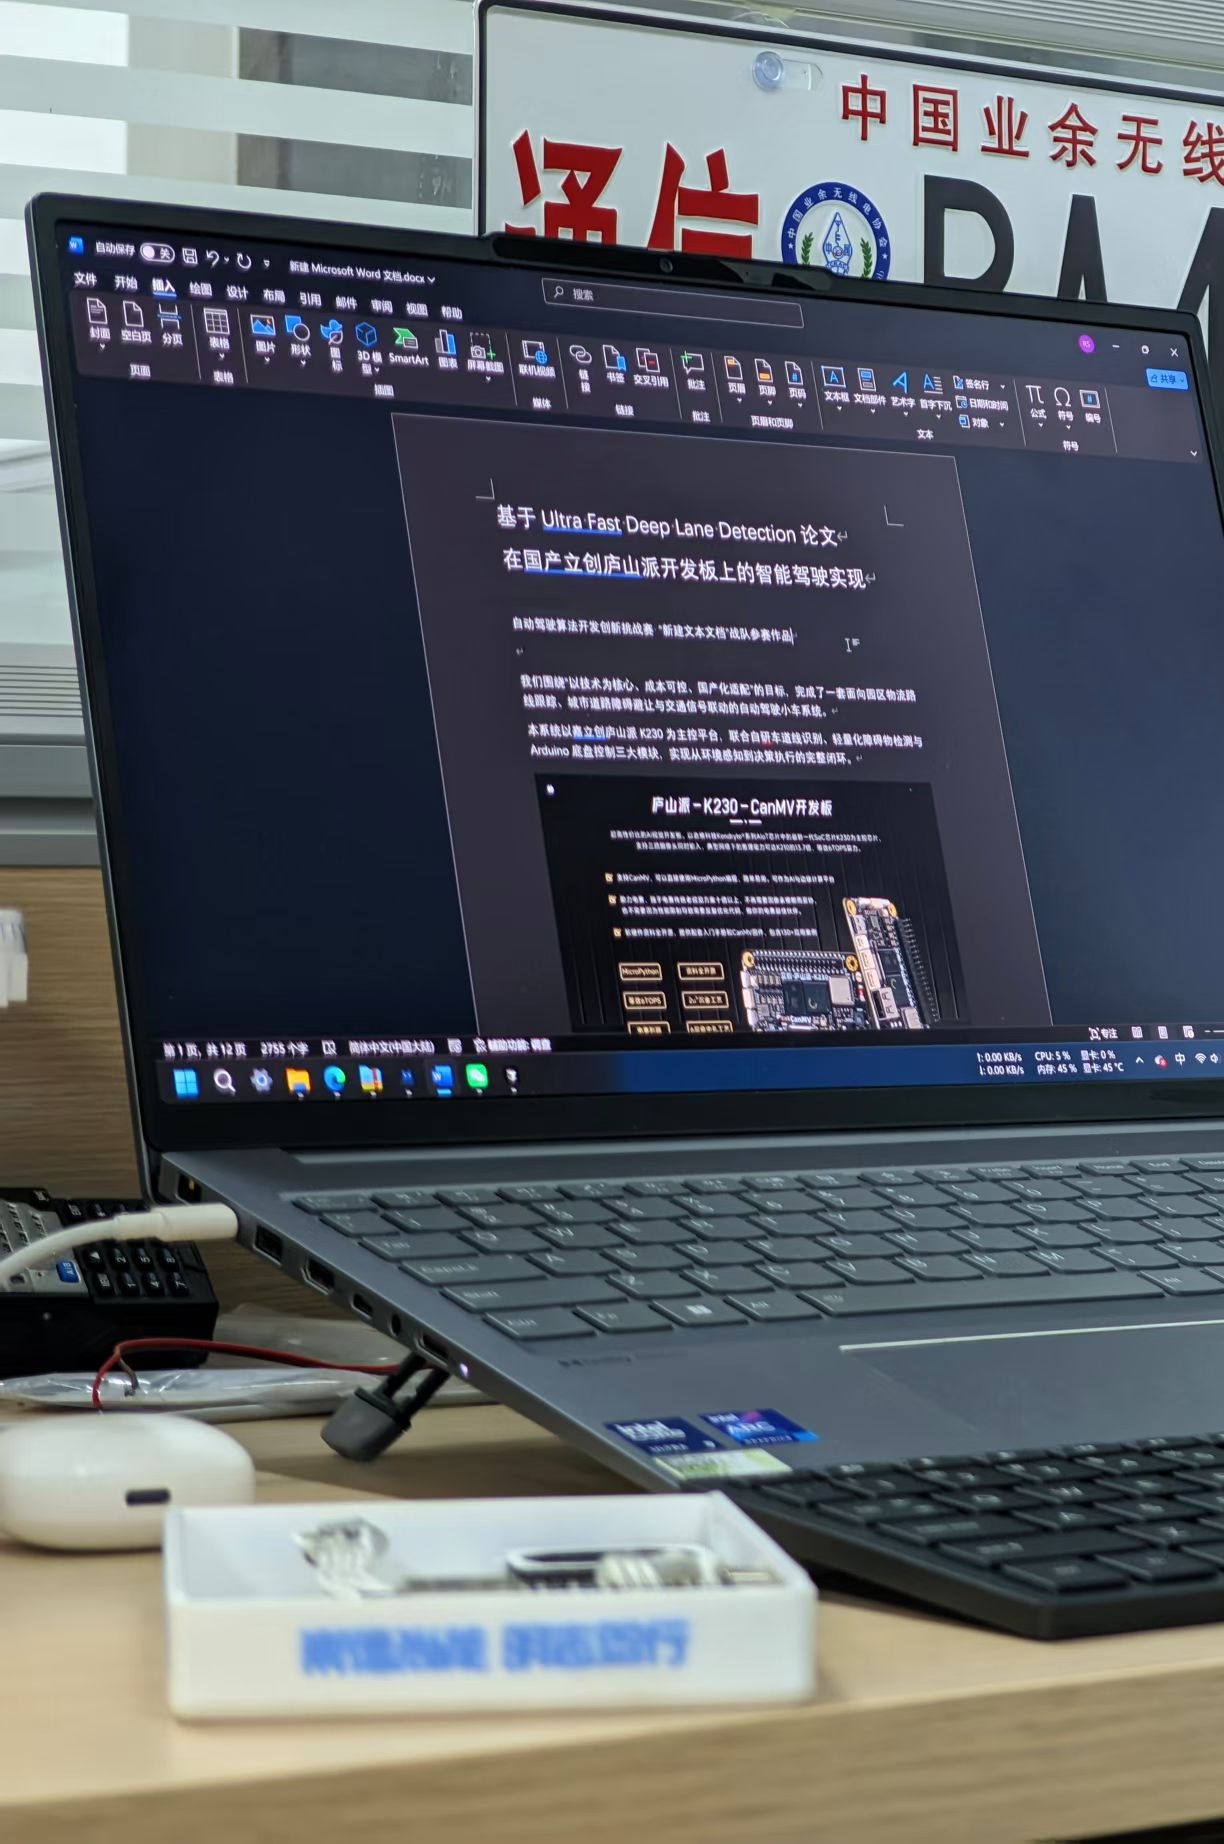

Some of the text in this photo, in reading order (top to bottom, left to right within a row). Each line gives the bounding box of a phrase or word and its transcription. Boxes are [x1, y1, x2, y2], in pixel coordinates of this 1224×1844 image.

[95, 241, 135, 256] 自动保存
[160, 247, 171, 259] 关
[289, 260, 425, 283] 新建 Microsoft Word 文档.docx
[74, 272, 97, 286] 文件
[114, 275, 138, 290] 开始
[152, 278, 176, 292] 插入
[189, 282, 212, 296] 绘图
[226, 285, 249, 300] 设计
[573, 288, 594, 301] 搜索
[263, 289, 285, 303] 布局
[299, 292, 322, 307] 引用
[335, 296, 358, 310] 邮件
[371, 299, 393, 314] 审阅
[406, 302, 428, 316] 视图
[441, 306, 463, 320] 帮助
[90, 327, 111, 340] 封面
[121, 329, 152, 343] 空白页
[162, 332, 183, 346] 分页
[209, 337, 230, 349] 表格
[255, 341, 276, 354] 图片
[291, 343, 311, 356] 形状
[357, 350, 370, 361] 3D
[388, 352, 429, 366] SmartArt
[438, 357, 458, 369] 图表
[467, 359, 504, 373] 屏幕截图
[130, 363, 151, 377] 页面
[213, 370, 234, 383] 表格
[518, 363, 555, 378] 联机视频
[606, 371, 625, 383] 书签
[633, 374, 669, 388] 交叉引用
[1160, 374, 1177, 385] 共享
[374, 383, 394, 397] 插图
[687, 378, 705, 391] 批注
[728, 382, 746, 394] 页眉
[758, 384, 776, 396] 页脚
[965, 379, 989, 390] 签名行
[789, 387, 806, 399] 页码
[824, 391, 849, 402] 文本框
[853, 393, 886, 405] 文档部件
[532, 398, 551, 409] 媒体
[890, 396, 915, 408] 艺术字
[920, 398, 953, 411] 首字下沉
[969, 399, 1009, 411] 日期和时间
[615, 404, 634, 416] 链接
[692, 410, 711, 422] 批注
[1030, 409, 1047, 419] 公式
[1057, 410, 1073, 421] 符号
[751, 415, 793, 429] 页眉和页脚
[972, 417, 989, 429] 对象
[1085, 412, 1101, 423] 编号
[917, 429, 934, 440] 文本
[1063, 441, 1079, 452] 符号
[497, 504, 838, 547] 基于 Ultra Fast Deep Lane Detection 论文
[503, 547, 867, 590] 在国产立创庐山派开发板上的智能驾驶实现
[639, 727, 664, 740] K230
[530, 744, 570, 757] Arduino
[1101, 1028, 1119, 1039] 专注
[1004, 1051, 1023, 1062] KB/s
[1035, 1051, 1055, 1061] CPU:
[1081, 1050, 1100, 1061] 显卡:
[1175, 1052, 1186, 1066] 中
[1006, 1064, 1025, 1075] KB/s
[1037, 1064, 1056, 1075] 内存:
[1083, 1063, 1101, 1074] 显卡:
